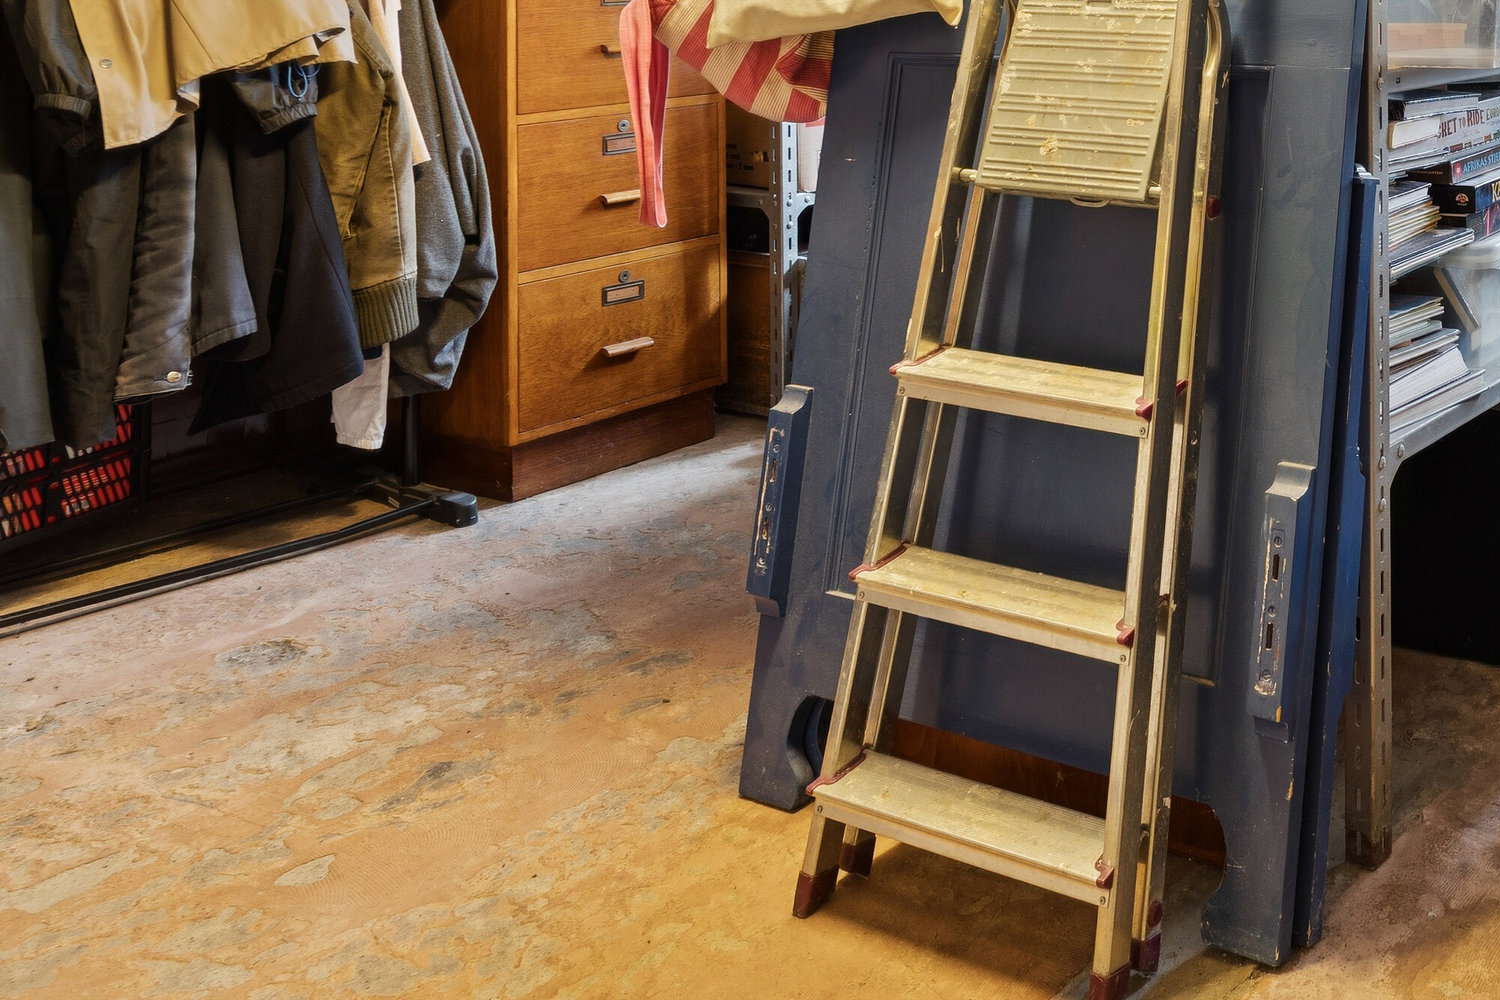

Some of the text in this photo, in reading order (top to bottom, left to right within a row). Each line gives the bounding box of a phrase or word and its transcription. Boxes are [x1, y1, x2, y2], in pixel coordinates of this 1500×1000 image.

[1438, 117, 1457, 138] KET
[1458, 117, 1466, 129] TO
[1467, 109, 1485, 127] RIDE
[1463, 156, 1488, 173] AFRIKAS
